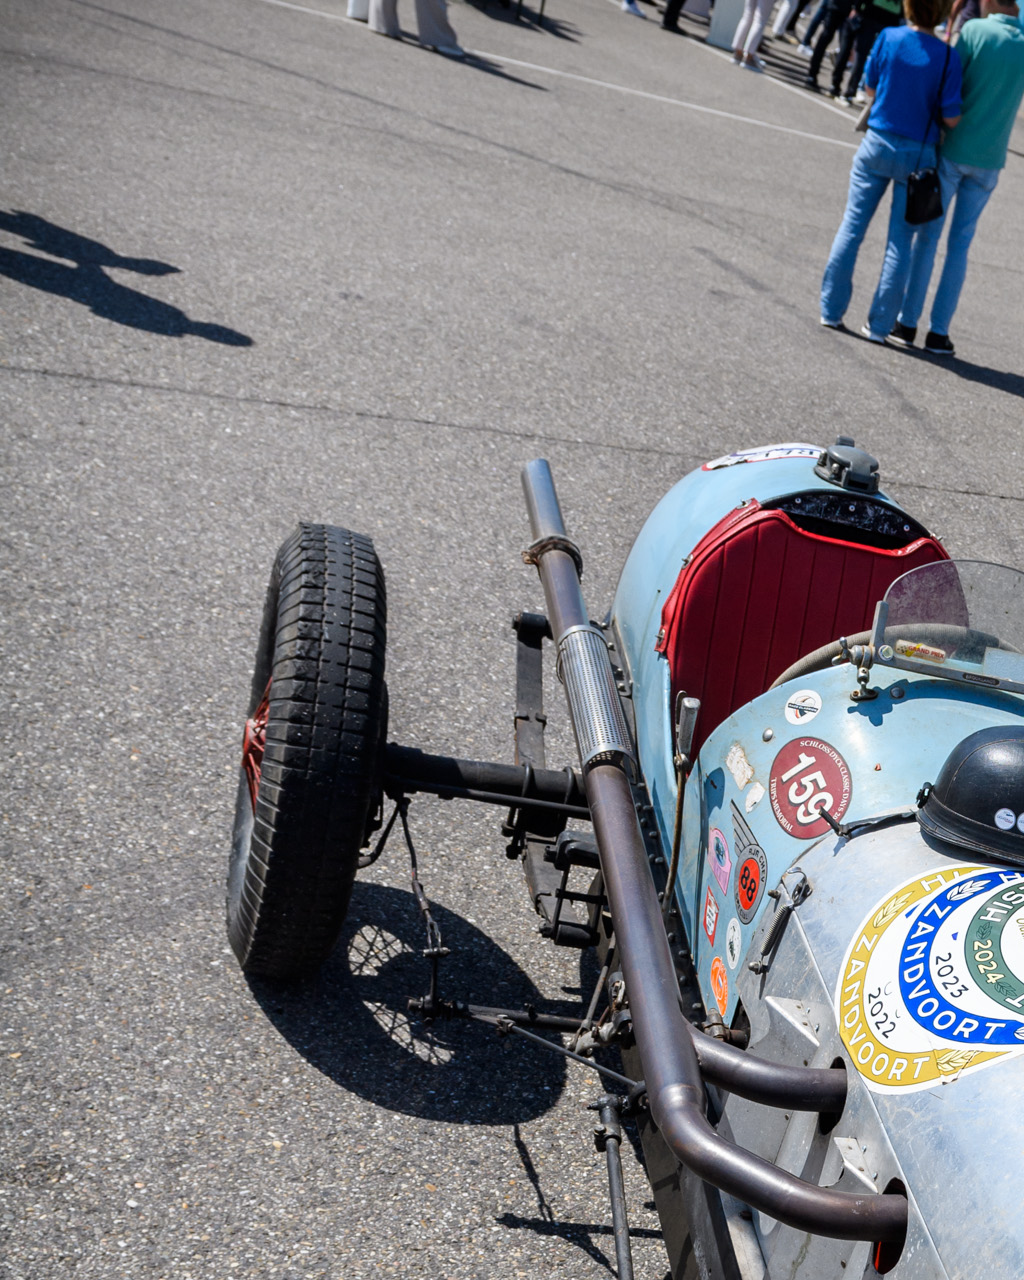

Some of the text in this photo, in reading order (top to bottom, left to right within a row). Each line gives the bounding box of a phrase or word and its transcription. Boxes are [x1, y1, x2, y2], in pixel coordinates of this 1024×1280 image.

[908, 645, 930, 655] GRAND
[931, 651, 944, 659] PRIX
[781, 752, 834, 824] 159
[800, 740, 831, 754] SCHLOSS
[829, 751, 845, 769] DYCK
[839, 766, 850, 793] CLASSIC
[770, 777, 794, 832] TRIPS MEMORIAL
[740, 866, 756, 902] 88
[904, 902, 1006, 1040] ZANDVOORT
[935, 952, 969, 999] 2023
[973, 939, 1004, 985] 2024
[844, 933, 931, 1080] ZANDVOORT
[868, 987, 896, 1039] 2022
